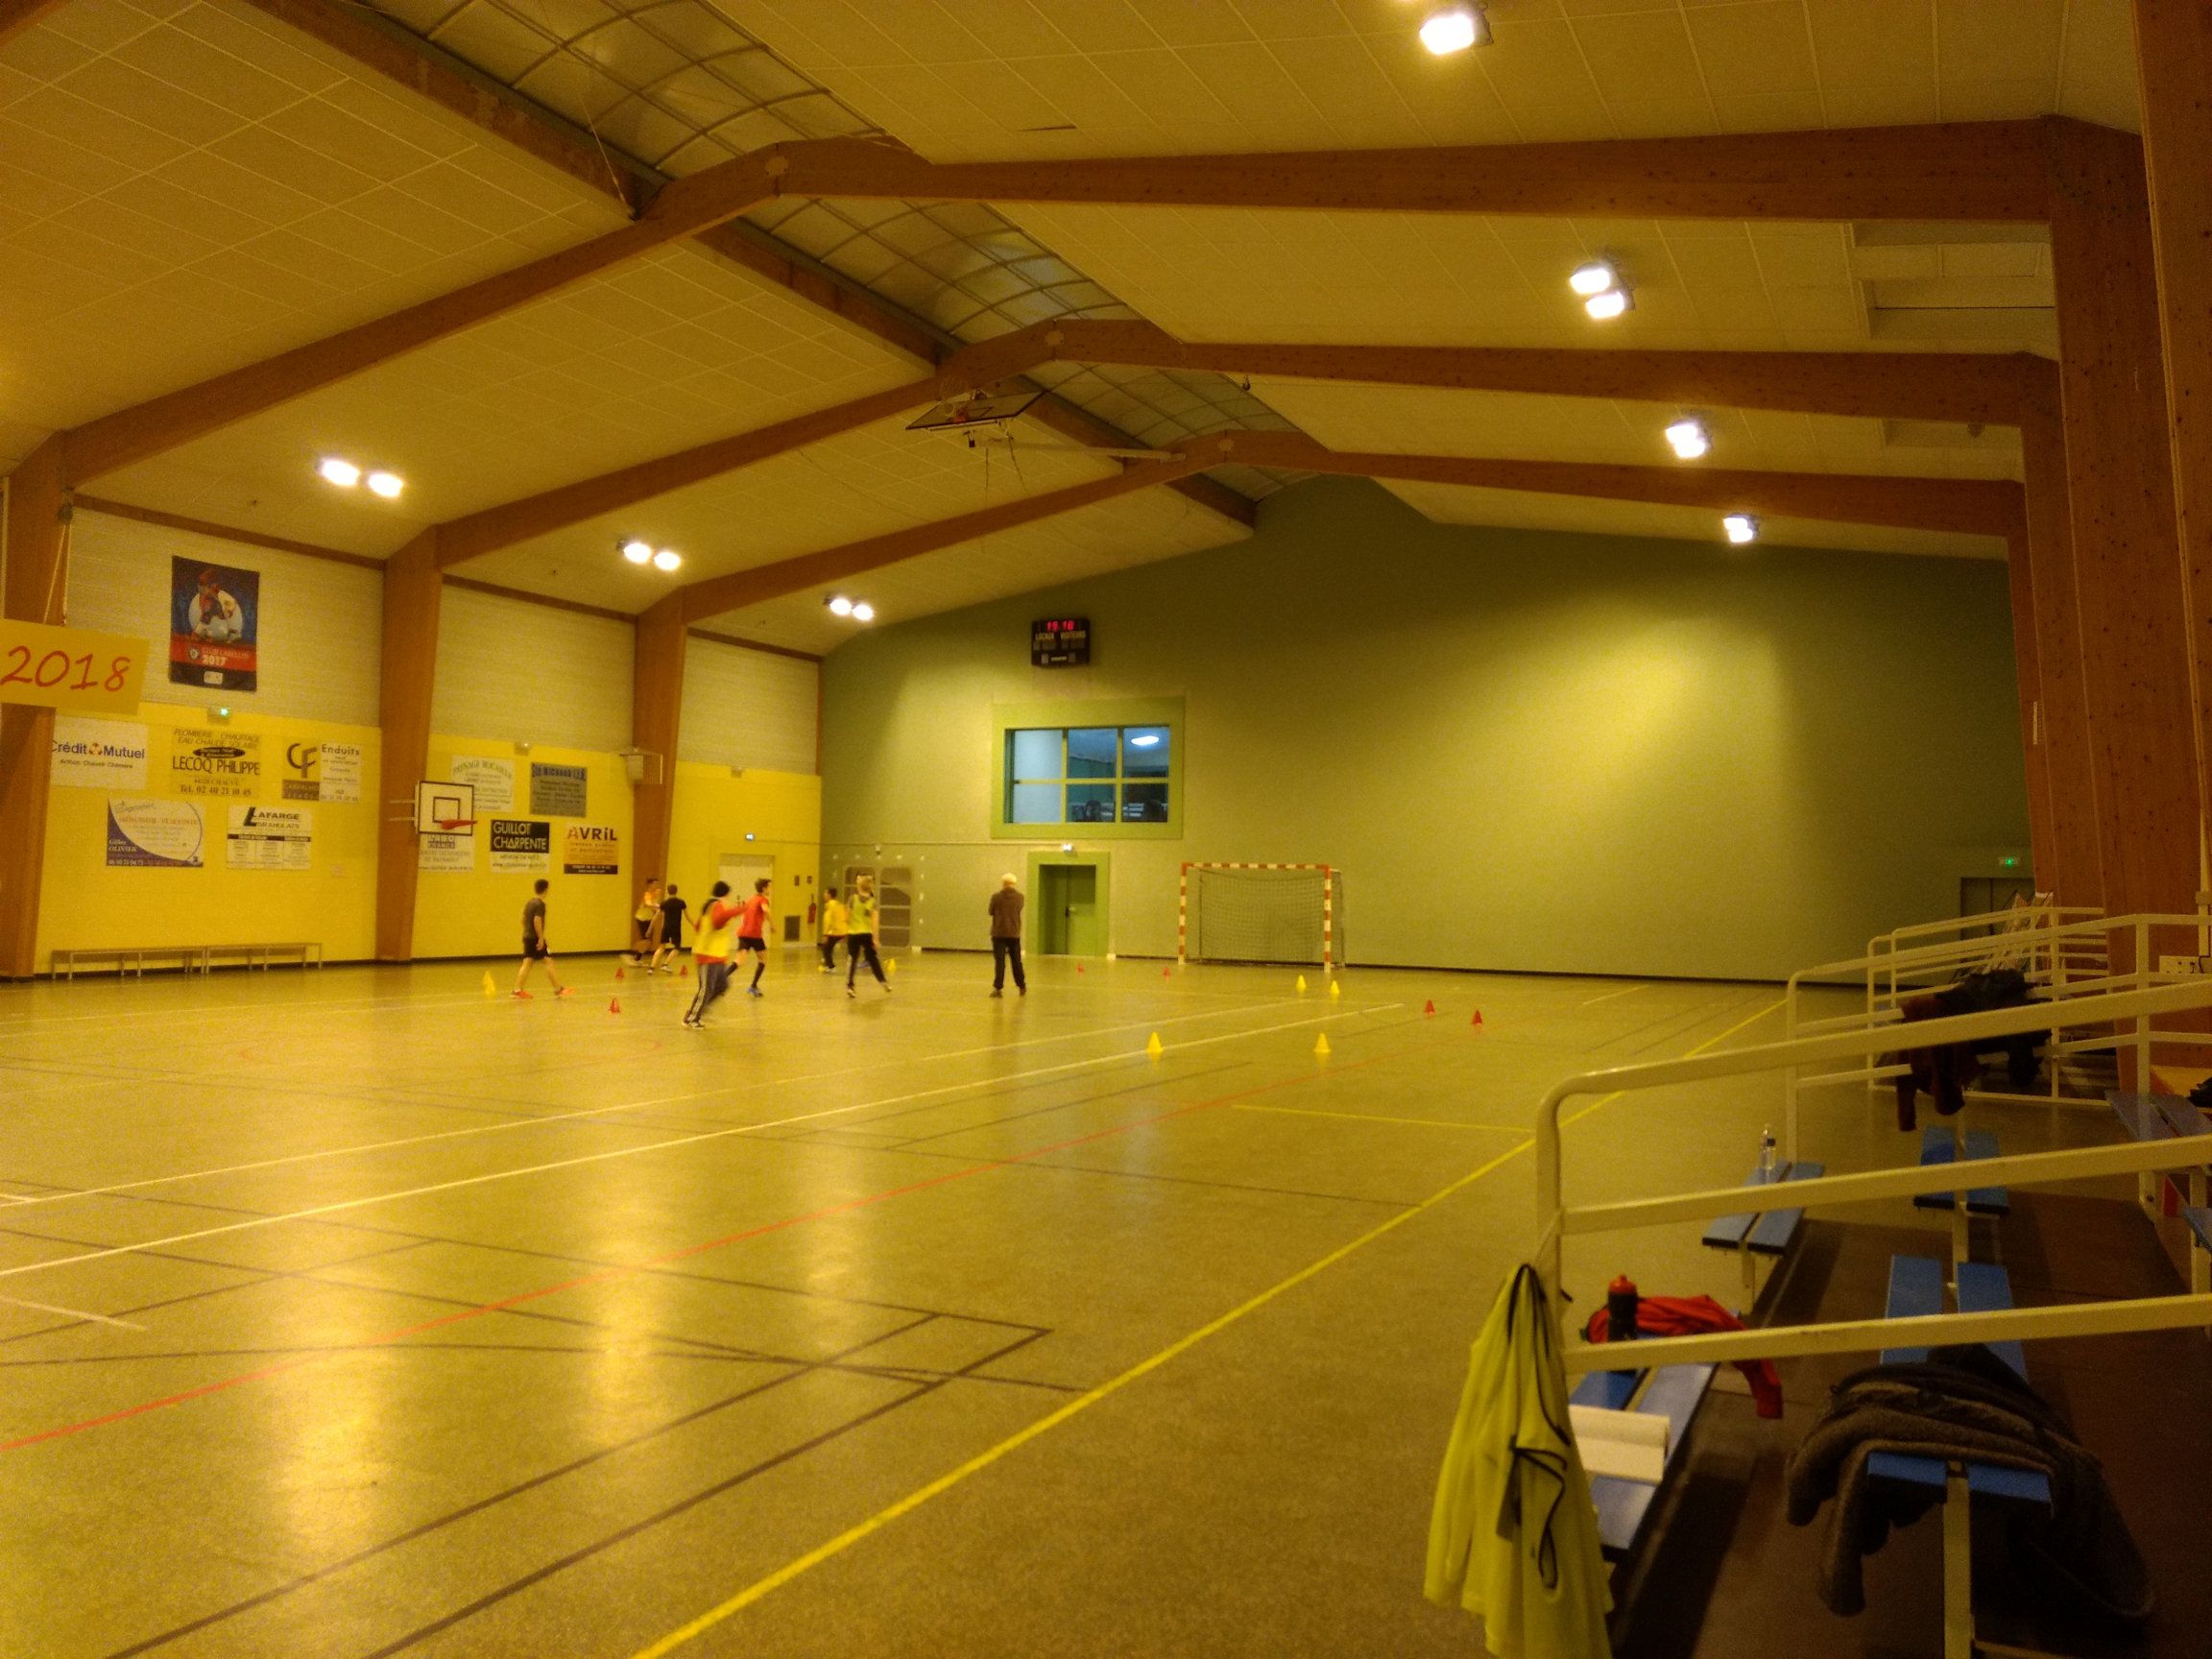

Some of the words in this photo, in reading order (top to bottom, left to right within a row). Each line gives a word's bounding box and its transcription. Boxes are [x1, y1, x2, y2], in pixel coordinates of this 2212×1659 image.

[0, 645, 131, 691] 2018
[103, 745, 145, 758] Mutuel
[321, 744, 360, 756] Enduits
[173, 756, 212, 774] LECOQ
[217, 759, 260, 776] PHILIPPE
[493, 822, 532, 834] GUILLOT
[493, 836, 546, 850] CHARPENTE
